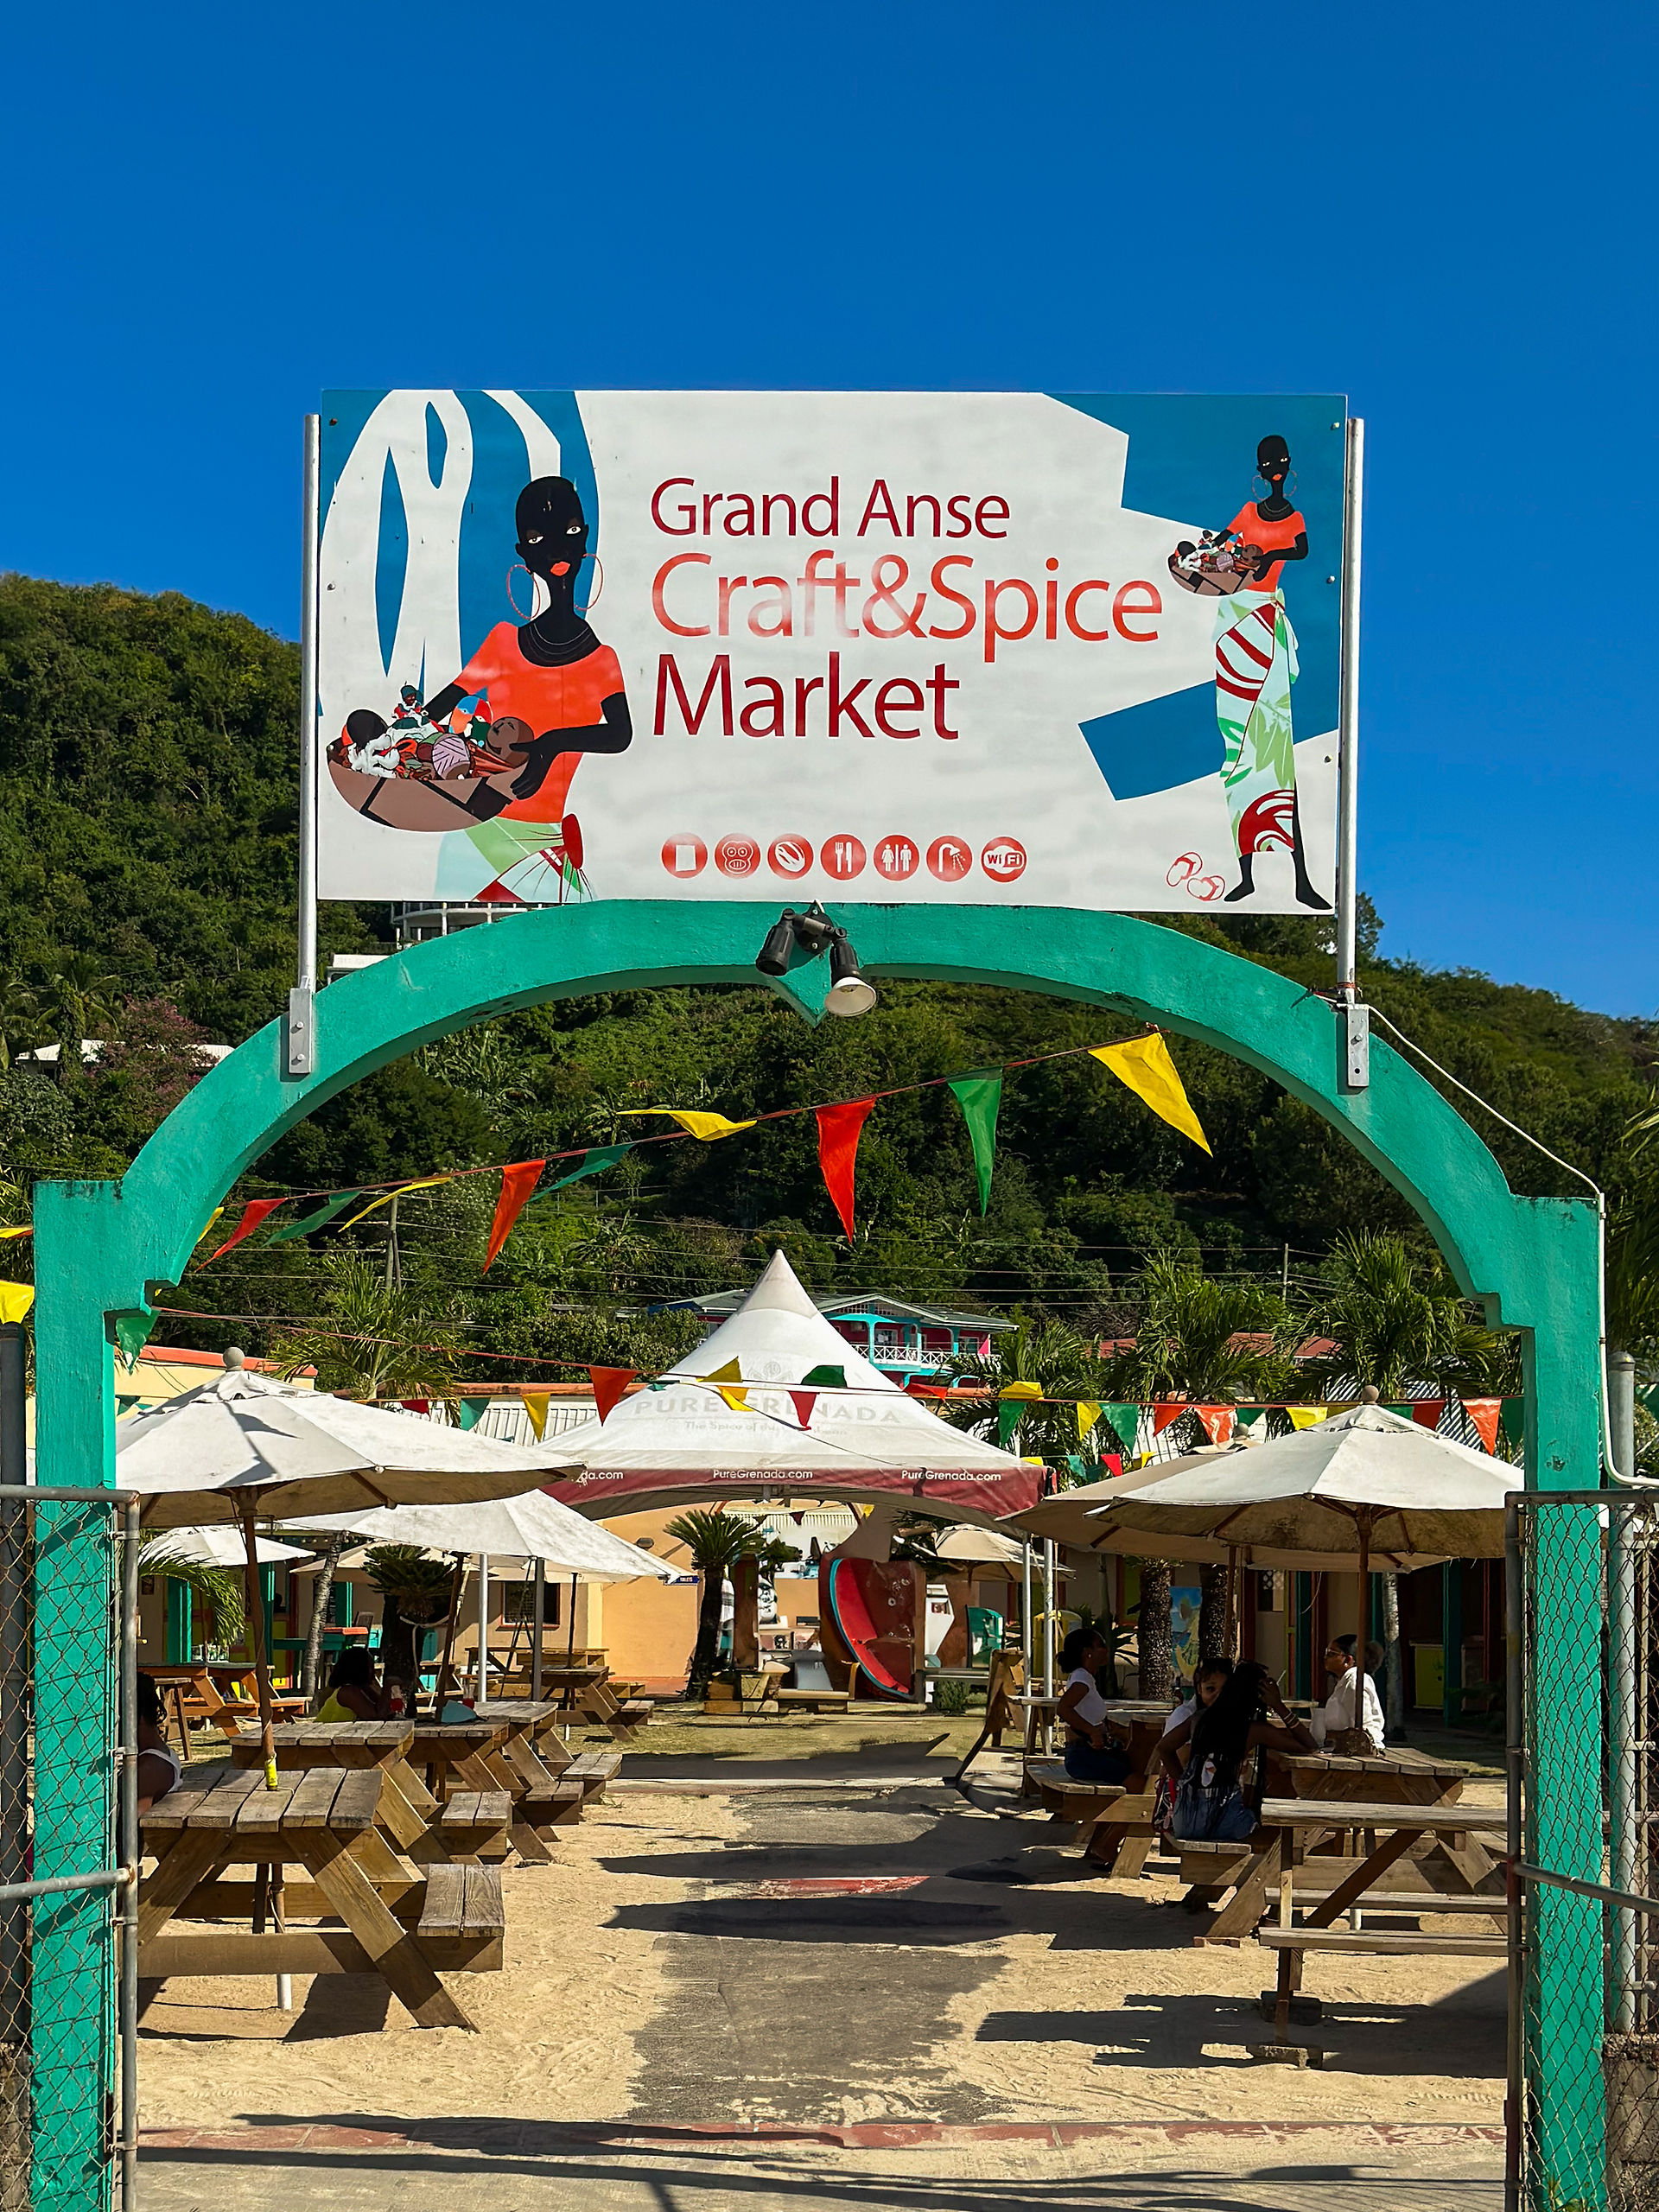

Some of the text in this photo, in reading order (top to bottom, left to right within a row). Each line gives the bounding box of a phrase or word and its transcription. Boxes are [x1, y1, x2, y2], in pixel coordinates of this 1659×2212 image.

[651, 475, 1011, 539] Grand Anse
[652, 549, 1163, 663] Craft&Spice
[653, 652, 960, 740] Market
[634, 1395, 900, 1423] PURE RENADA
[685, 1421, 707, 1430] The
[713, 1469, 813, 1479] PureGrenada.com
[901, 1470, 1001, 1481] PureGrenada.com
